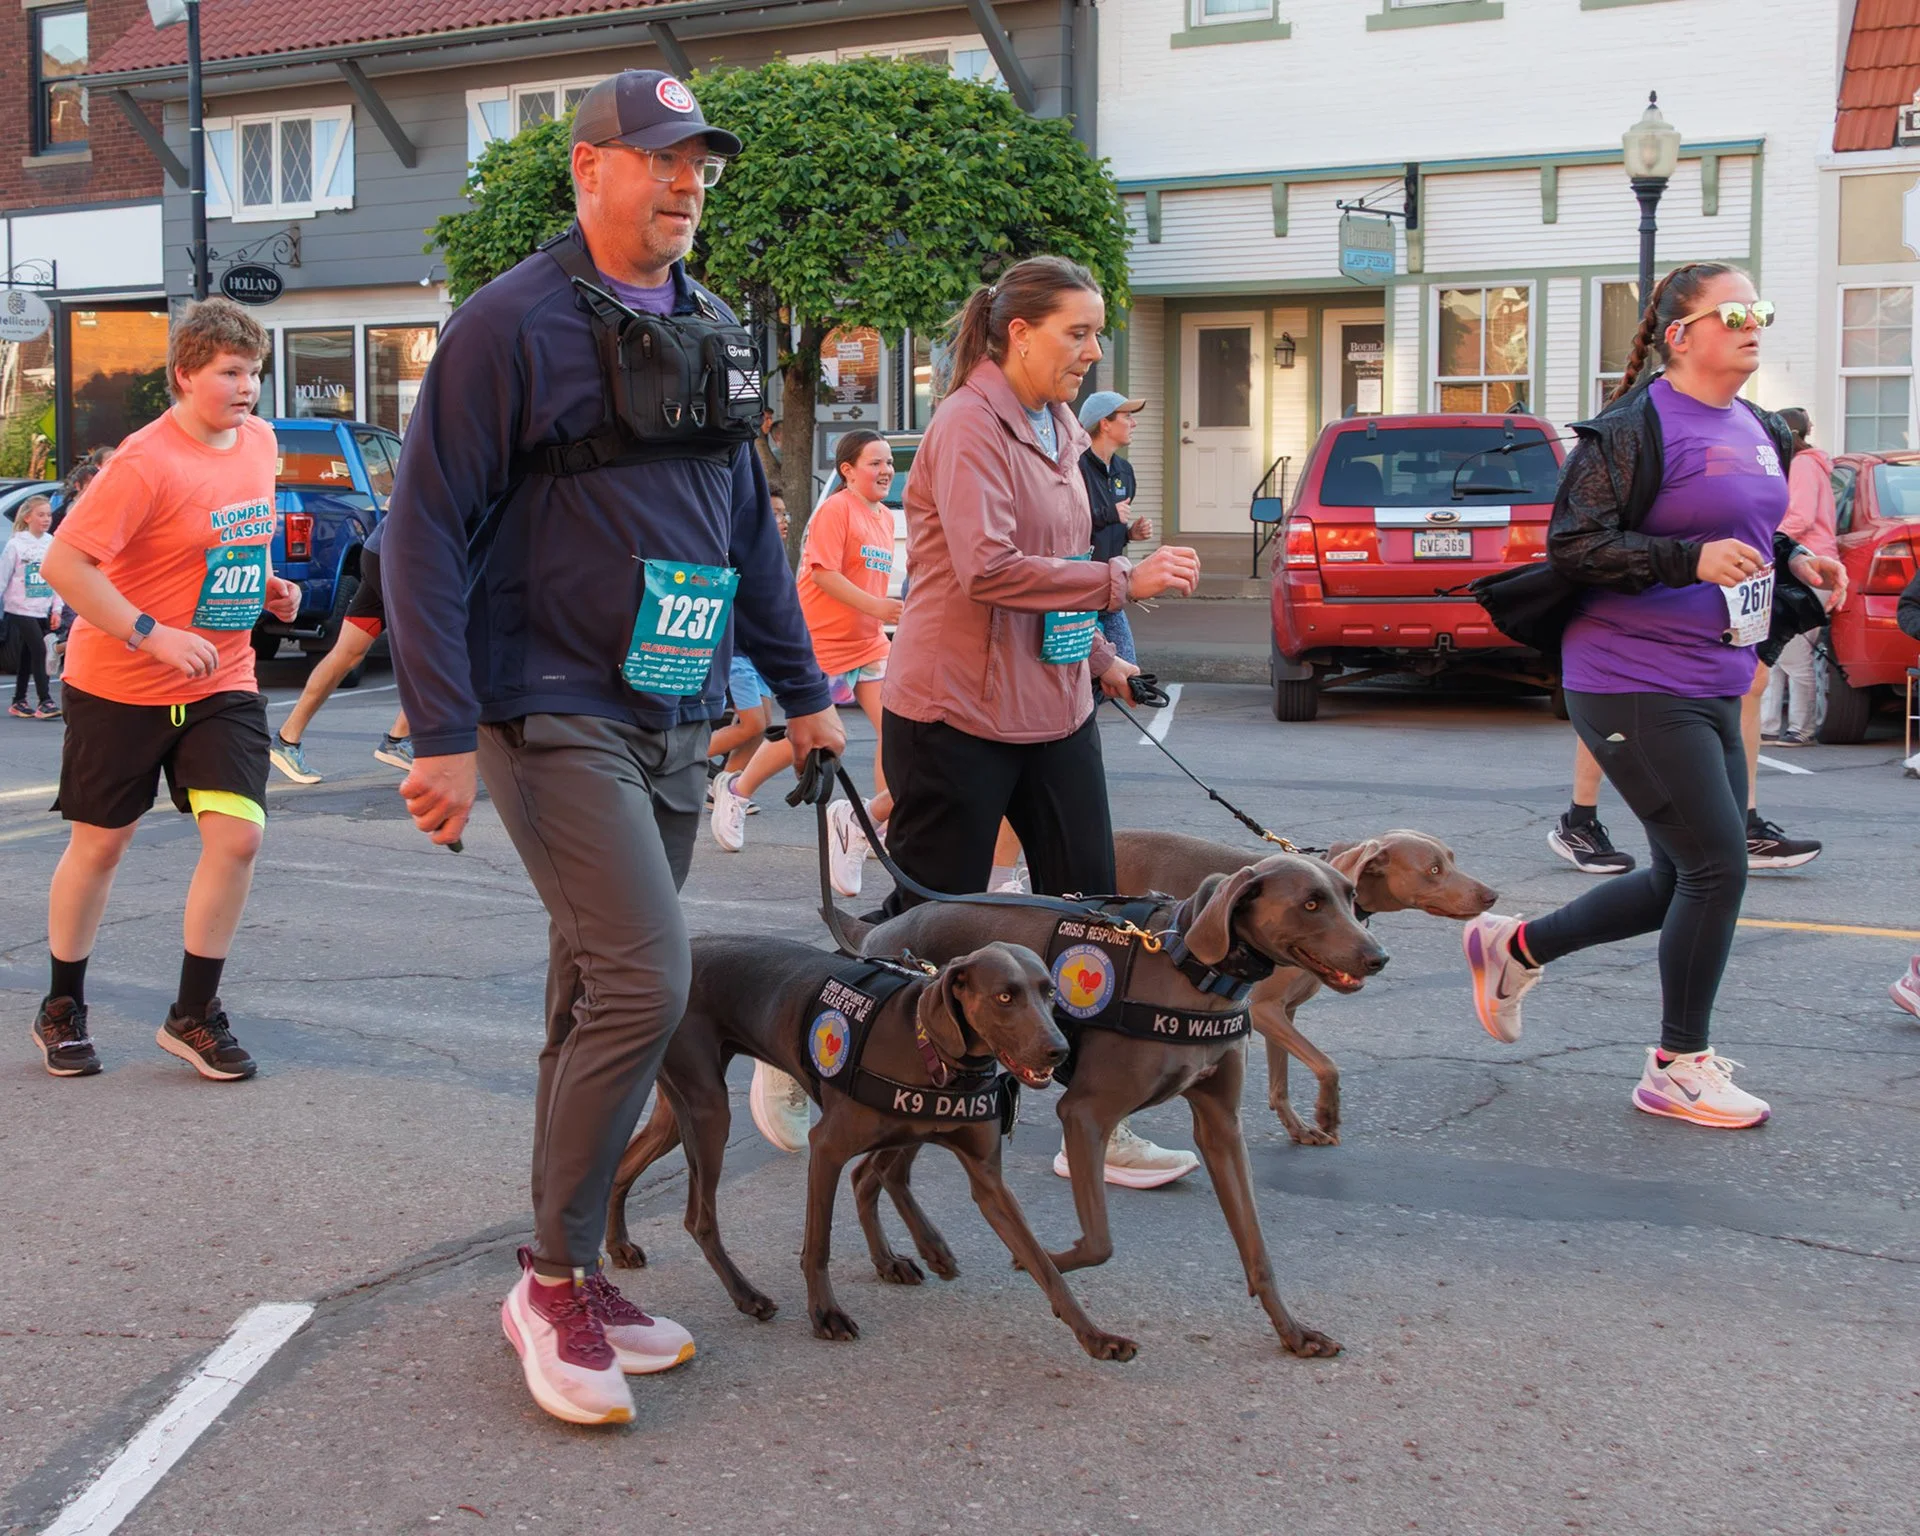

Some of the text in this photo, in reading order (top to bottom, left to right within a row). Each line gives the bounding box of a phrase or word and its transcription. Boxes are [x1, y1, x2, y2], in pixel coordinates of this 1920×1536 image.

[229, 276, 278, 292] HOLLAND
[295, 384, 345, 399] HOLLAND
[210, 503, 270, 529] KLOMPEN
[220, 520, 273, 542] CLASSIC
[1420, 539, 1465, 552] GVE 369
[210, 564, 261, 594] 2072
[655, 593, 724, 640] 1237
[1058, 921, 1130, 946] CRISIS RESPONSE
[825, 979, 843, 995] CRISIS
[819, 988, 868, 1023] PLEASE PET ME
[1153, 1013, 1244, 1037] K9 WALTER
[893, 1088, 998, 1117] K9 DAISY
